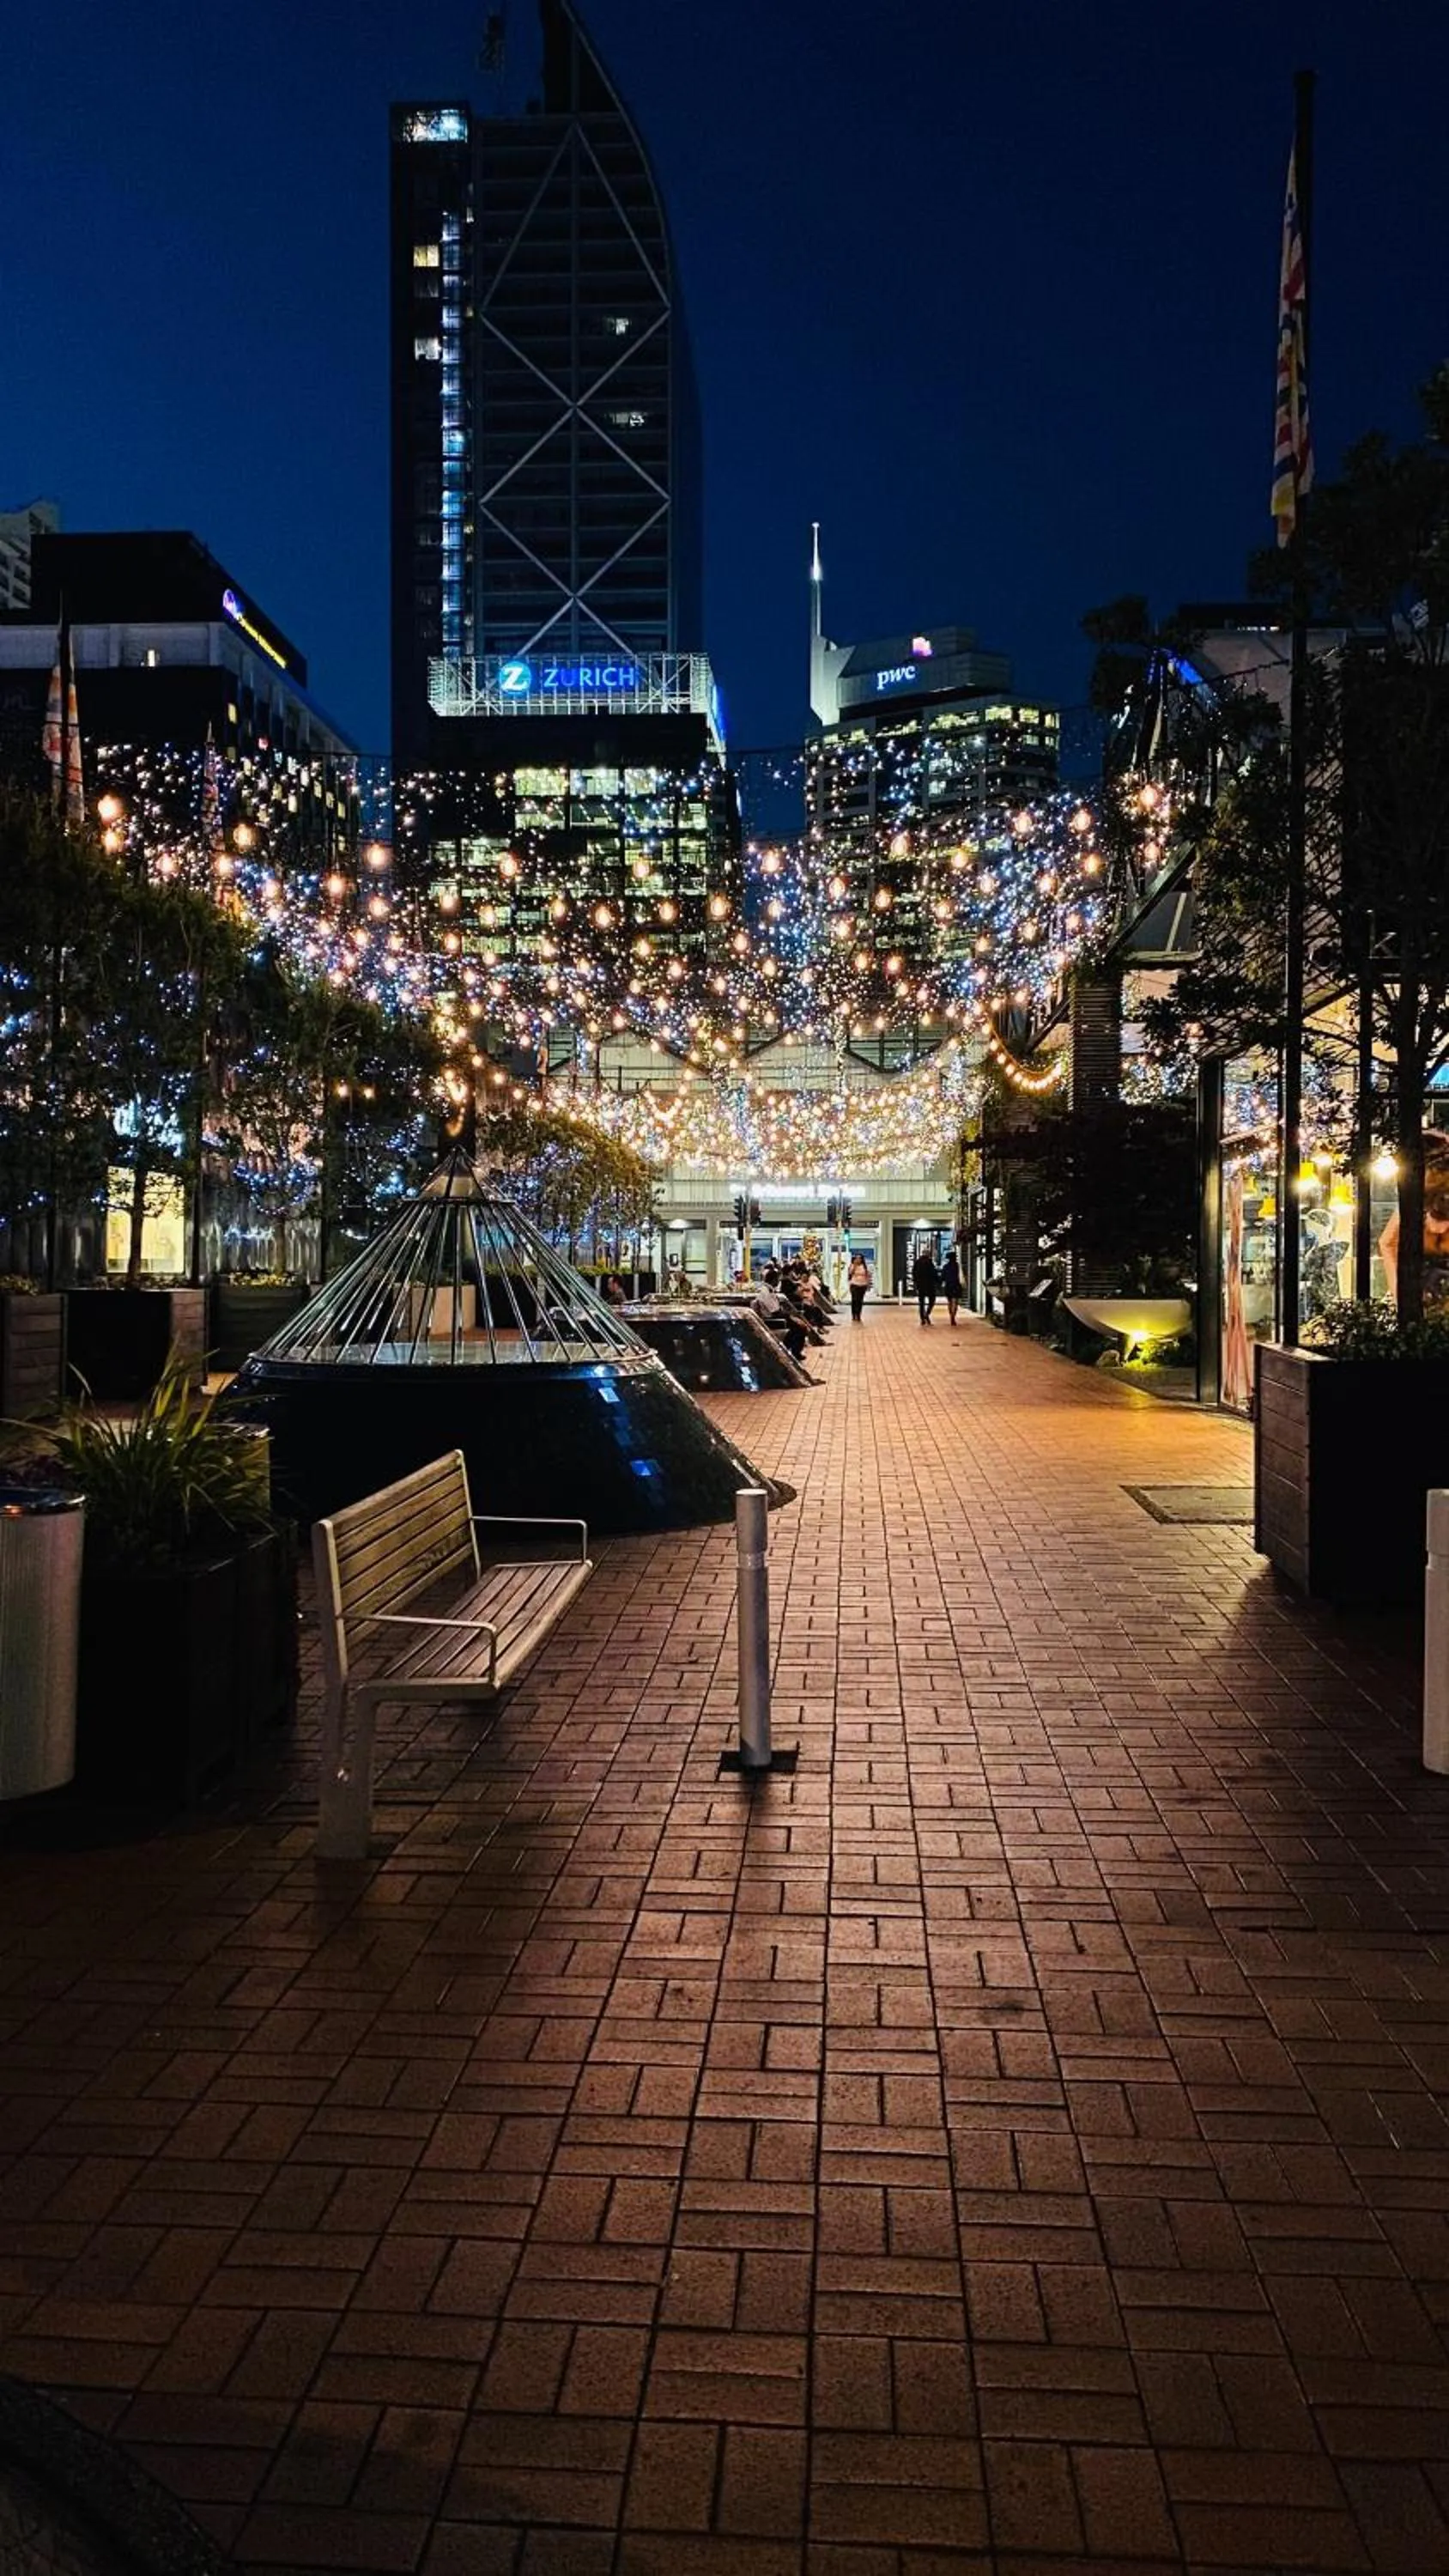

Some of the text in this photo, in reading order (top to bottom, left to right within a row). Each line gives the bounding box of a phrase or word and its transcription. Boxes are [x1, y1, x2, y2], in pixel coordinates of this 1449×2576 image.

[500, 666, 635, 691] Z ZURICH
[876, 665, 916, 690] pwc
